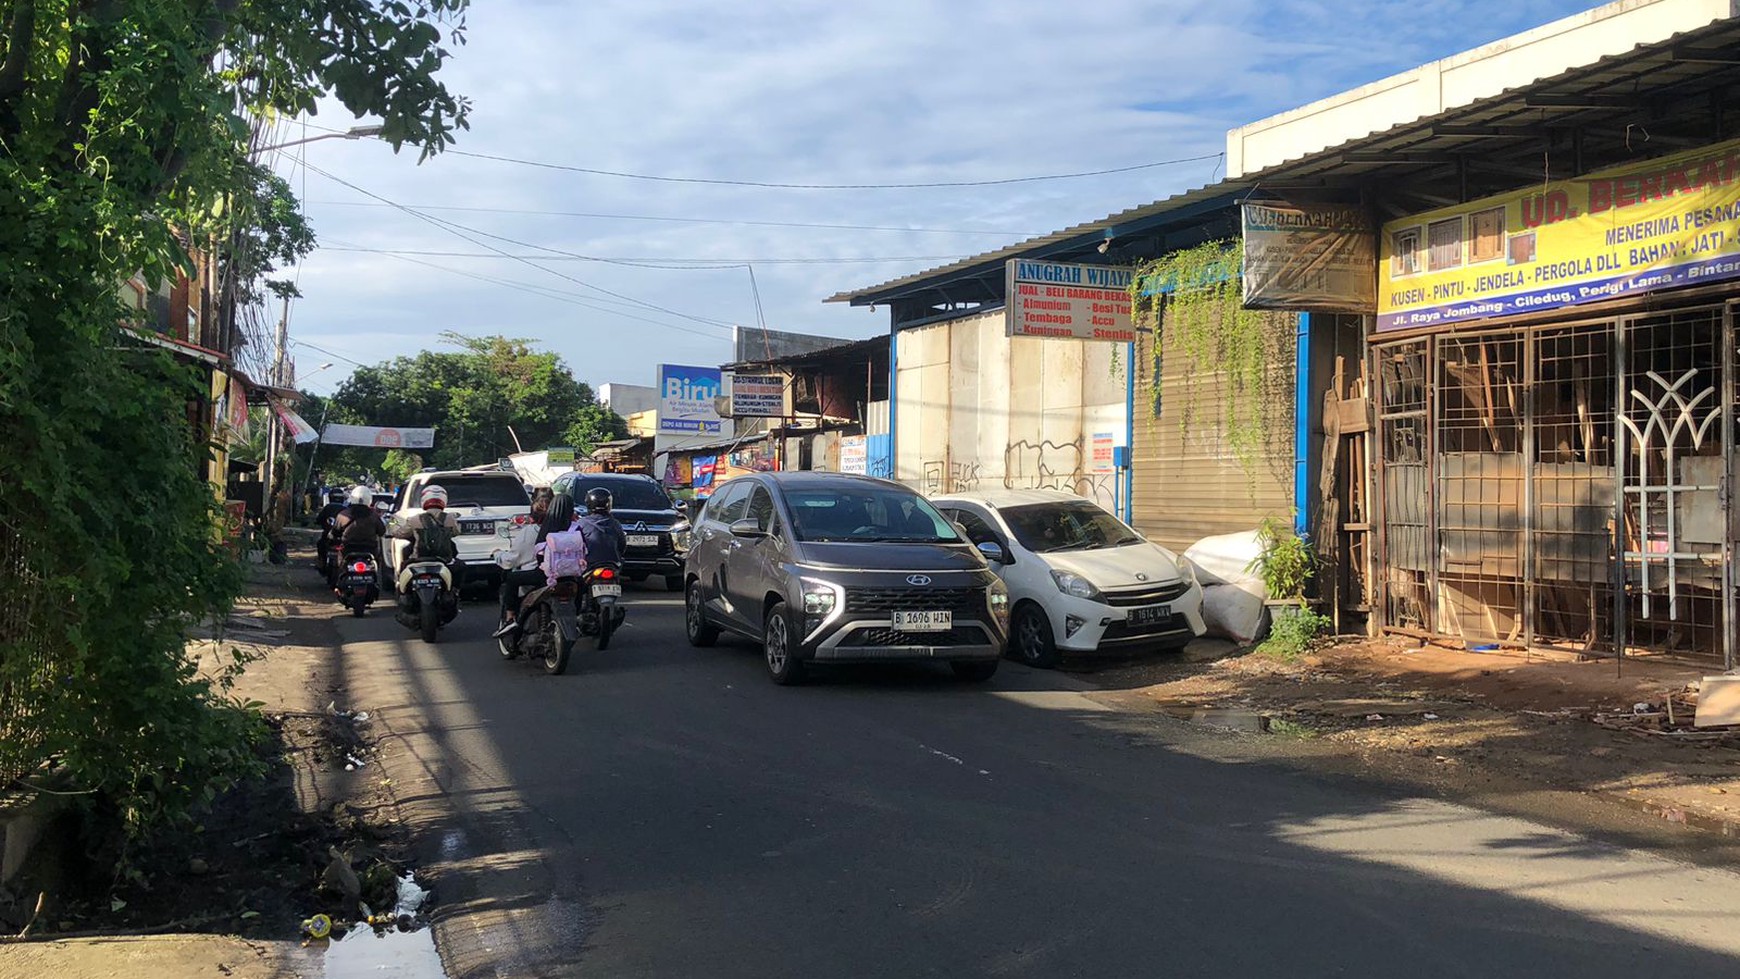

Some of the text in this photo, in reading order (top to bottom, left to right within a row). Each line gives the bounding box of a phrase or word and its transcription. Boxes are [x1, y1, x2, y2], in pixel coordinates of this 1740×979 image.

[1521, 188, 1577, 228] UD.
[1606, 216, 1679, 245] MENERIMA
[1018, 262, 1132, 287] ANUGRAH WIJAYA
[1391, 288, 1424, 307] KUSEN
[1434, 281, 1464, 300] PINTU
[1474, 270, 1524, 293] JENDELA
[1535, 258, 1593, 283] PERGOLA
[1597, 252, 1621, 272] DLL
[1691, 231, 1724, 254] JATI
[1018, 285, 1039, 296] JUAL
[1046, 287, 1064, 297] BELI
[1067, 289, 1103, 300] BARANG
[1105, 291, 1132, 302] BEKAS
[1393, 316, 1407, 326] Jl.
[1411, 312, 1440, 324] Raya
[1444, 302, 1503, 318] Jombang
[1515, 289, 1576, 307] Ciledug,
[1579, 283, 1623, 298] Perigi
[1629, 273, 1673, 289] Lama
[1024, 299, 1071, 310] Almunium
[1092, 303, 1113, 313] Besi
[1024, 312, 1072, 324] Tembaga
[1092, 316, 1115, 326] Accu
[1024, 325, 1072, 336] Kuningan
[1094, 329, 1133, 339] Stenlis
[667, 377, 717, 401] Biru
[895, 613, 901, 623] B
[907, 613, 929, 623] 1696
